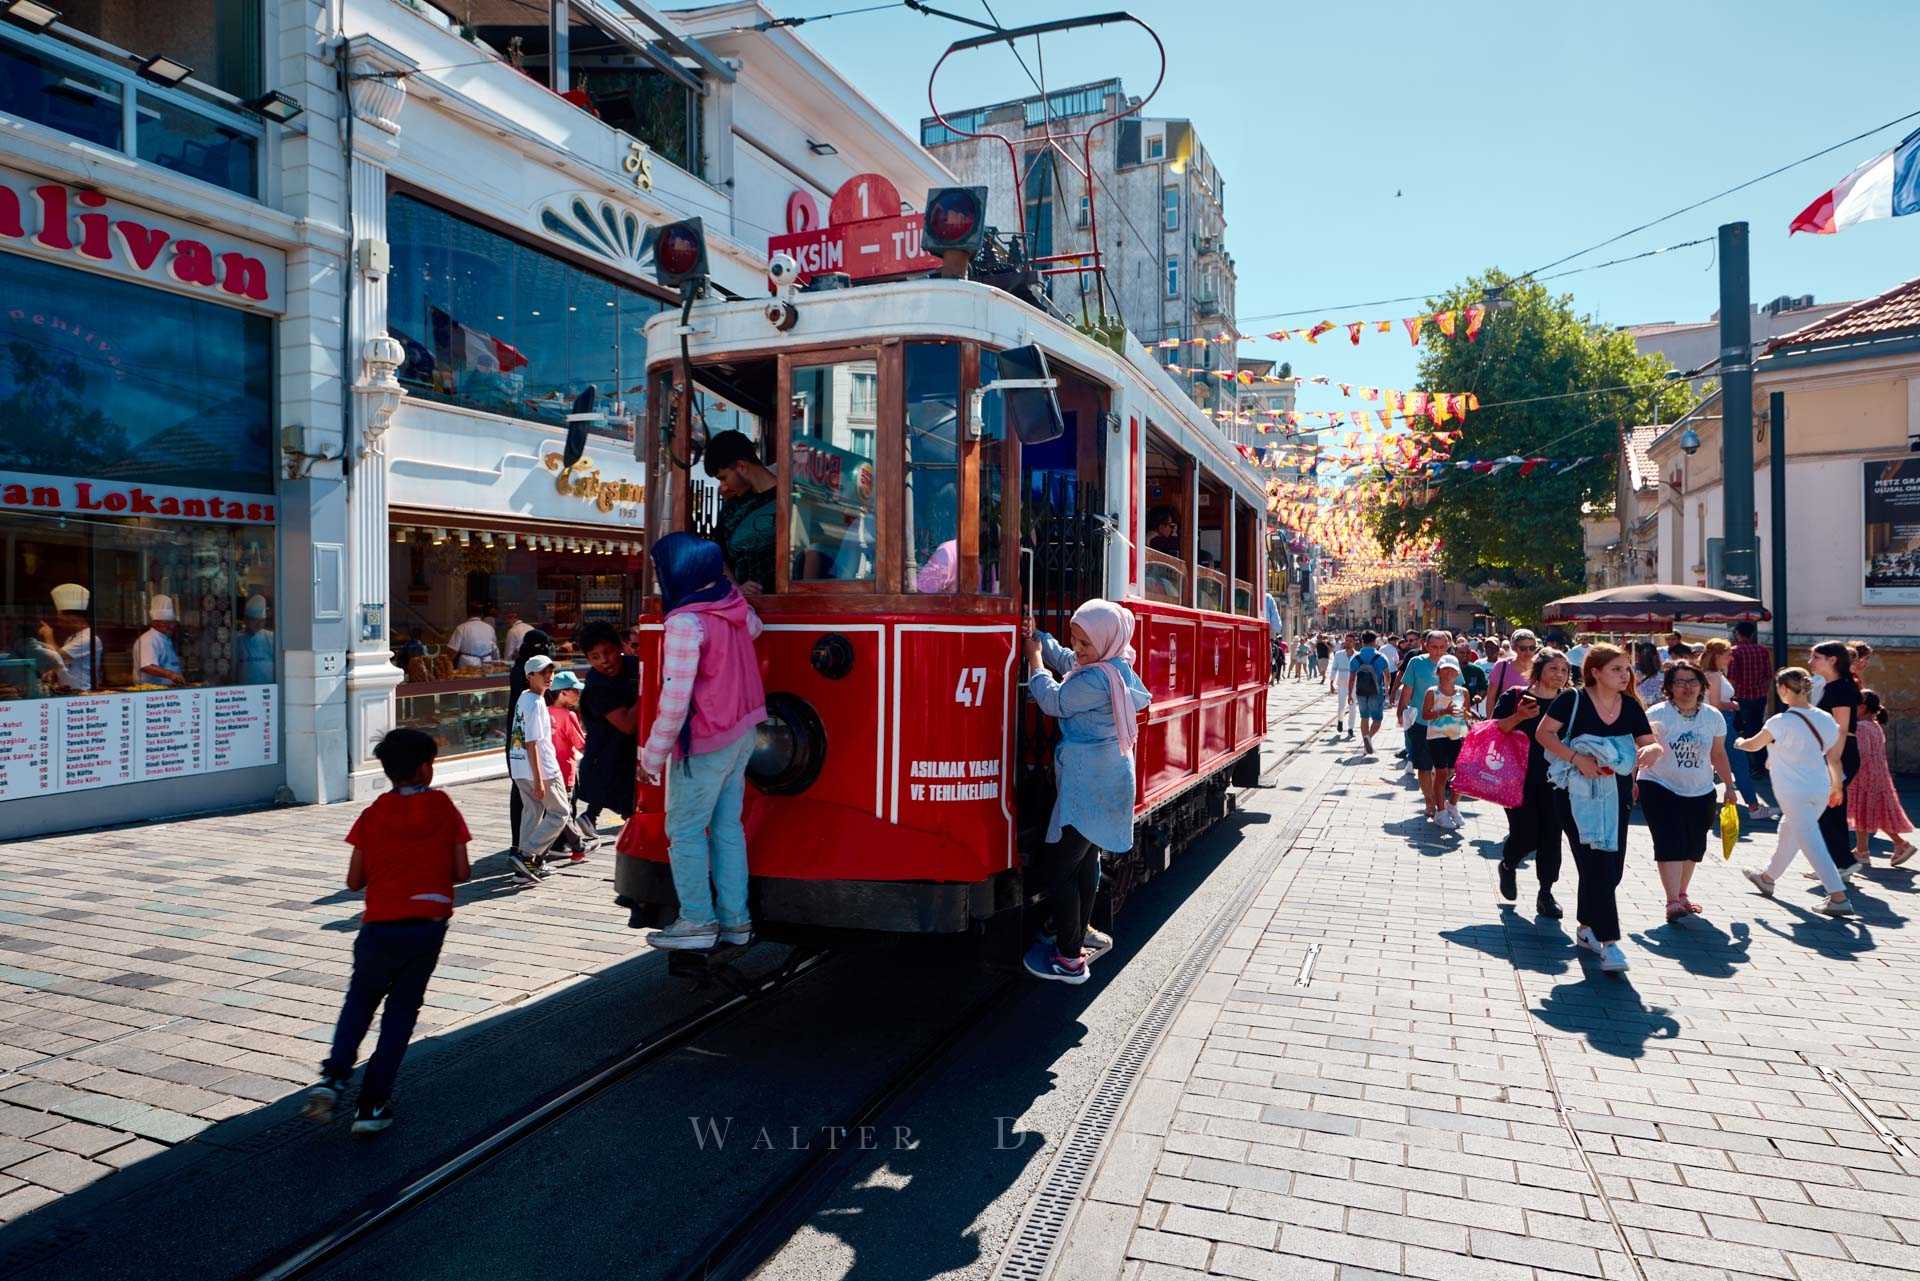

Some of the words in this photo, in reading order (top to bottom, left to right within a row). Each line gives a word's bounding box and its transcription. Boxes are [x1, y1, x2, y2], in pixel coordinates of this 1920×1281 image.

[858, 182, 870, 219] 1
[74, 482, 276, 522] Lokantası
[955, 667, 987, 707] 47
[910, 760, 966, 778] ASILMAK
[969, 760, 1000, 777] YASAK
[910, 784, 926, 801] VE
[929, 780, 999, 802] TEHLİKELİDİR
